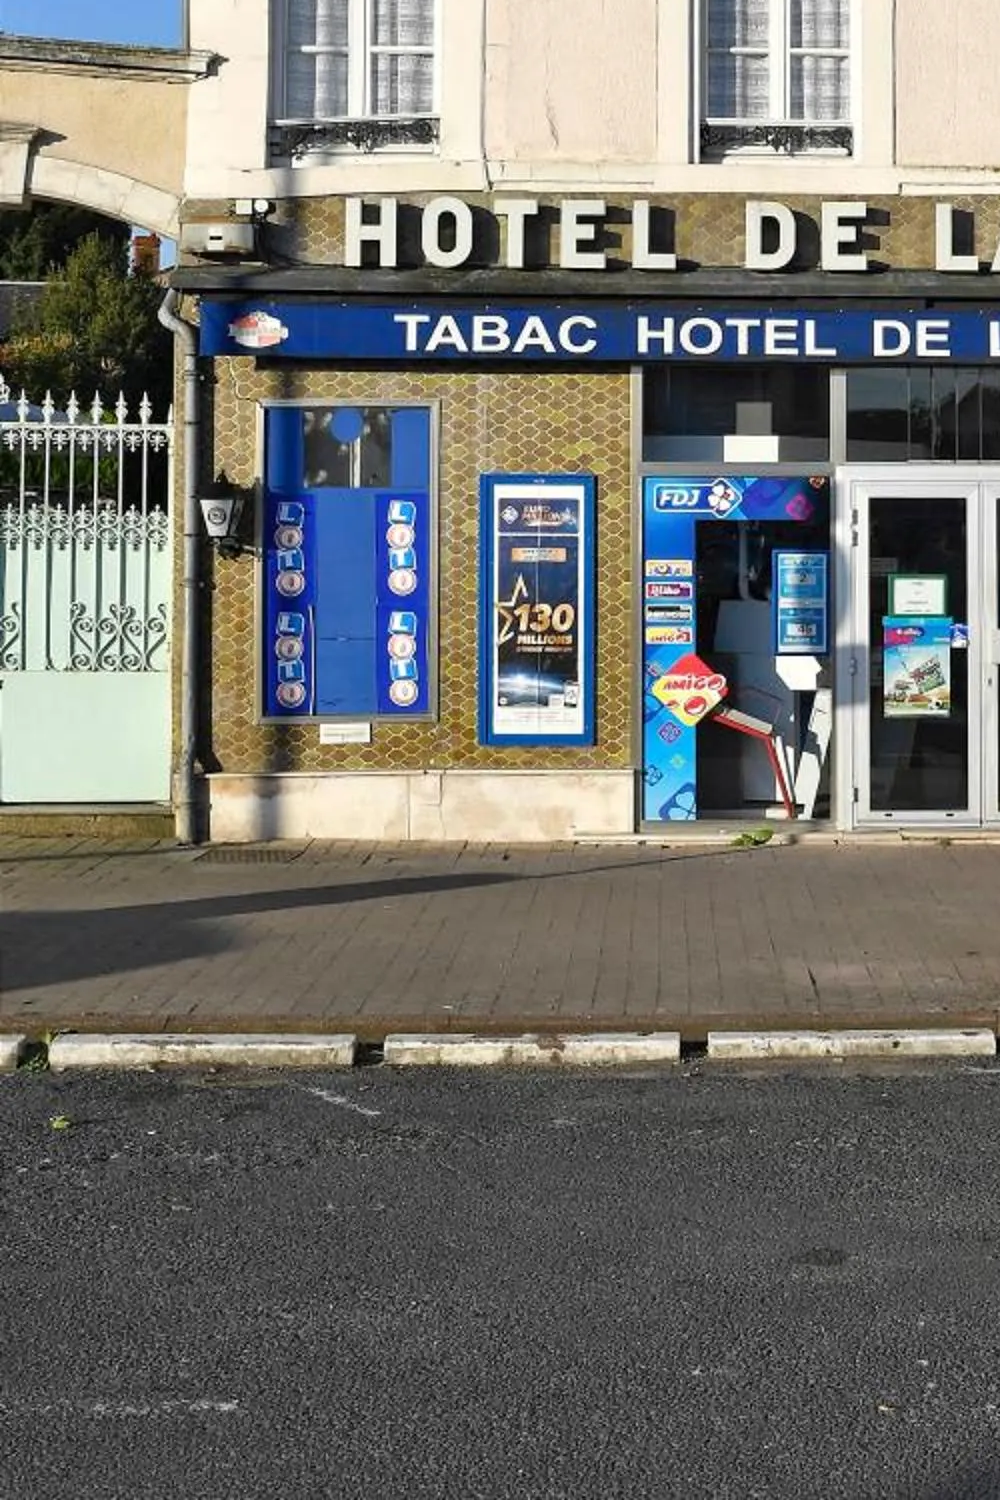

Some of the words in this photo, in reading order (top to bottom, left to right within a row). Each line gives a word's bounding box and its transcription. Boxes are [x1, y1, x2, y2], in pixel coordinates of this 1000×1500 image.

[345, 196, 677, 270] HOTEL
[745, 201, 868, 271] DE
[395, 314, 598, 354] TABAC
[636, 316, 836, 357] HOTEL
[872, 319, 951, 358] DE
[658, 488, 700, 508] FDJ
[513, 603, 575, 633] 130
[516, 634, 573, 645] MILLIONS
